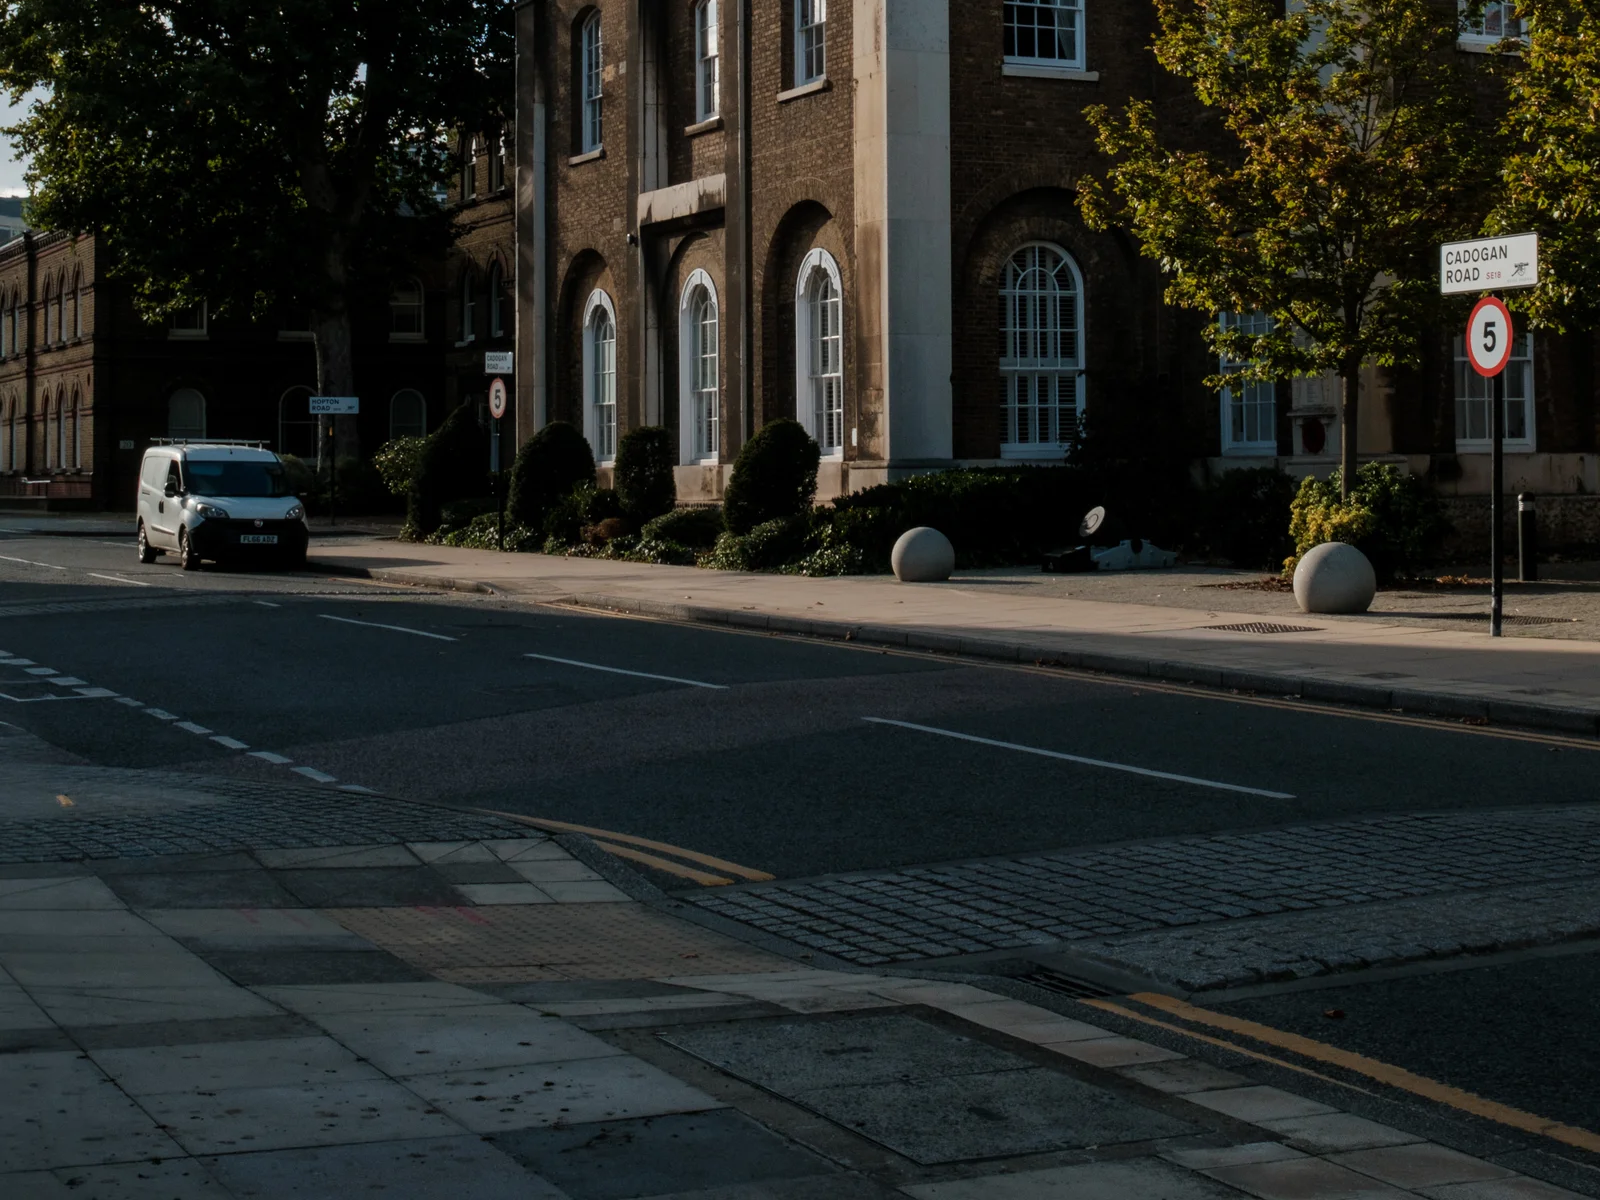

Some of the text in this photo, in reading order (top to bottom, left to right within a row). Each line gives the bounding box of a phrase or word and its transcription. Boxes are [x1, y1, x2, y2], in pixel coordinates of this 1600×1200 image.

[1445, 244, 1508, 266] CADOGAN
[1446, 267, 1480, 284] ROAD
[1485, 271, 1502, 280] SE18
[1482, 320, 1497, 353] 5
[494, 389, 501, 409] 5
